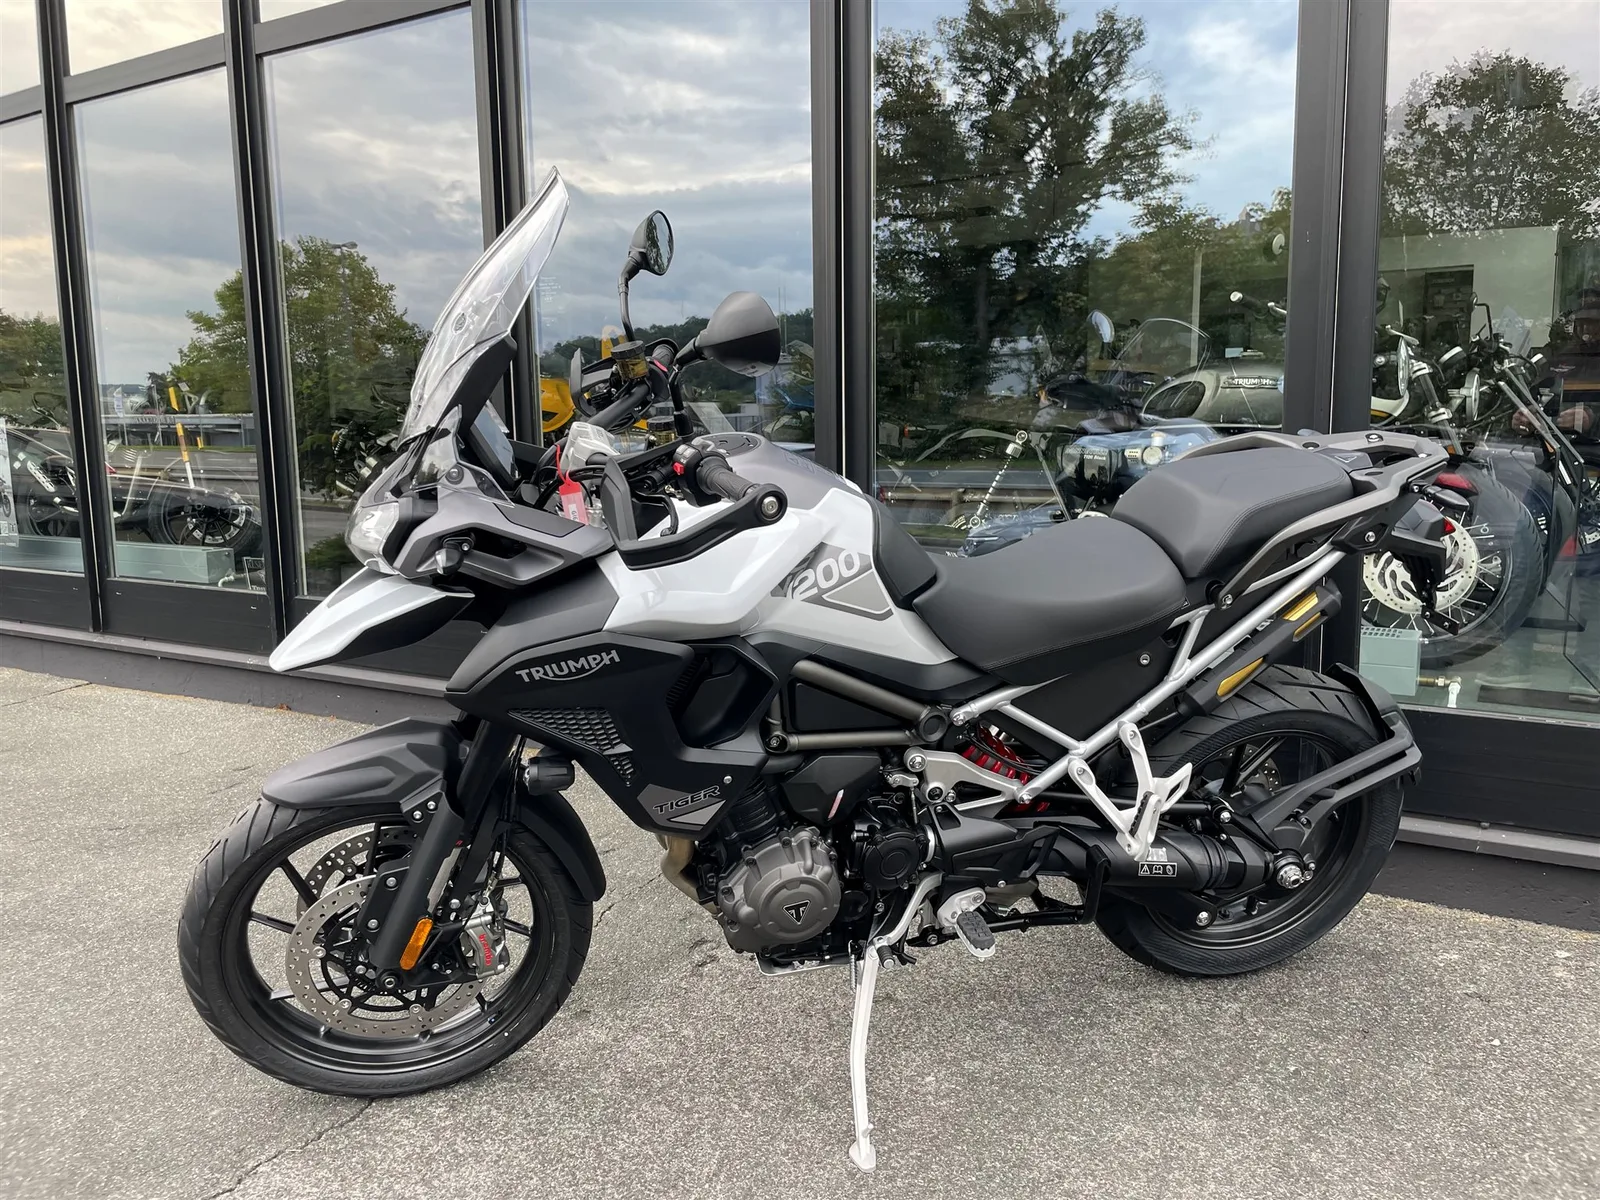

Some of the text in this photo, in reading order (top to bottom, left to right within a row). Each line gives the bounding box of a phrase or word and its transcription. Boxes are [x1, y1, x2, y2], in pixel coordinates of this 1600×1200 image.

[515, 650, 620, 683] TRIUMPH
[653, 785, 720, 814] TIGER
[478, 933, 493, 967] brembo
